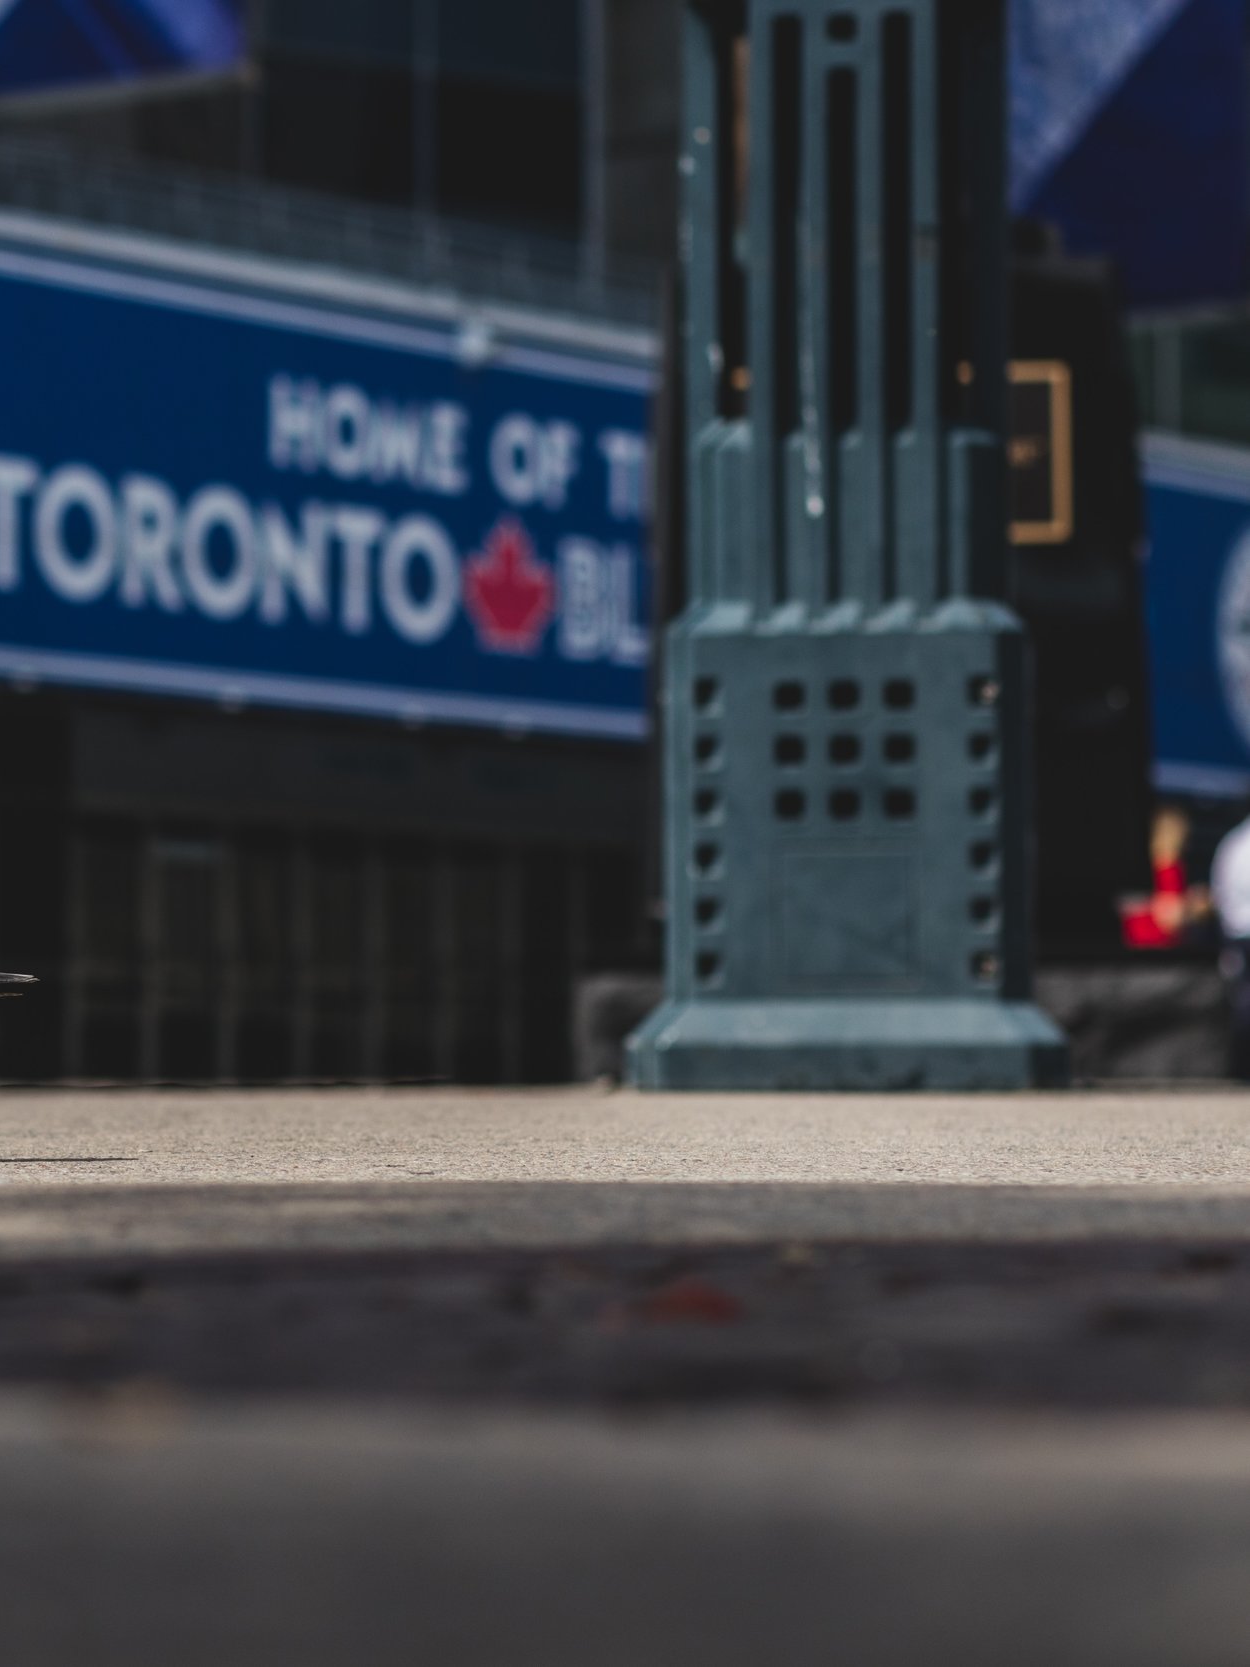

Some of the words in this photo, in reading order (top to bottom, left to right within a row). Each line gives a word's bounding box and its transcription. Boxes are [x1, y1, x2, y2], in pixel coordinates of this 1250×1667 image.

[269, 375, 467, 494] HOME
[490, 412, 578, 508] OF
[557, 535, 648, 667] BL
